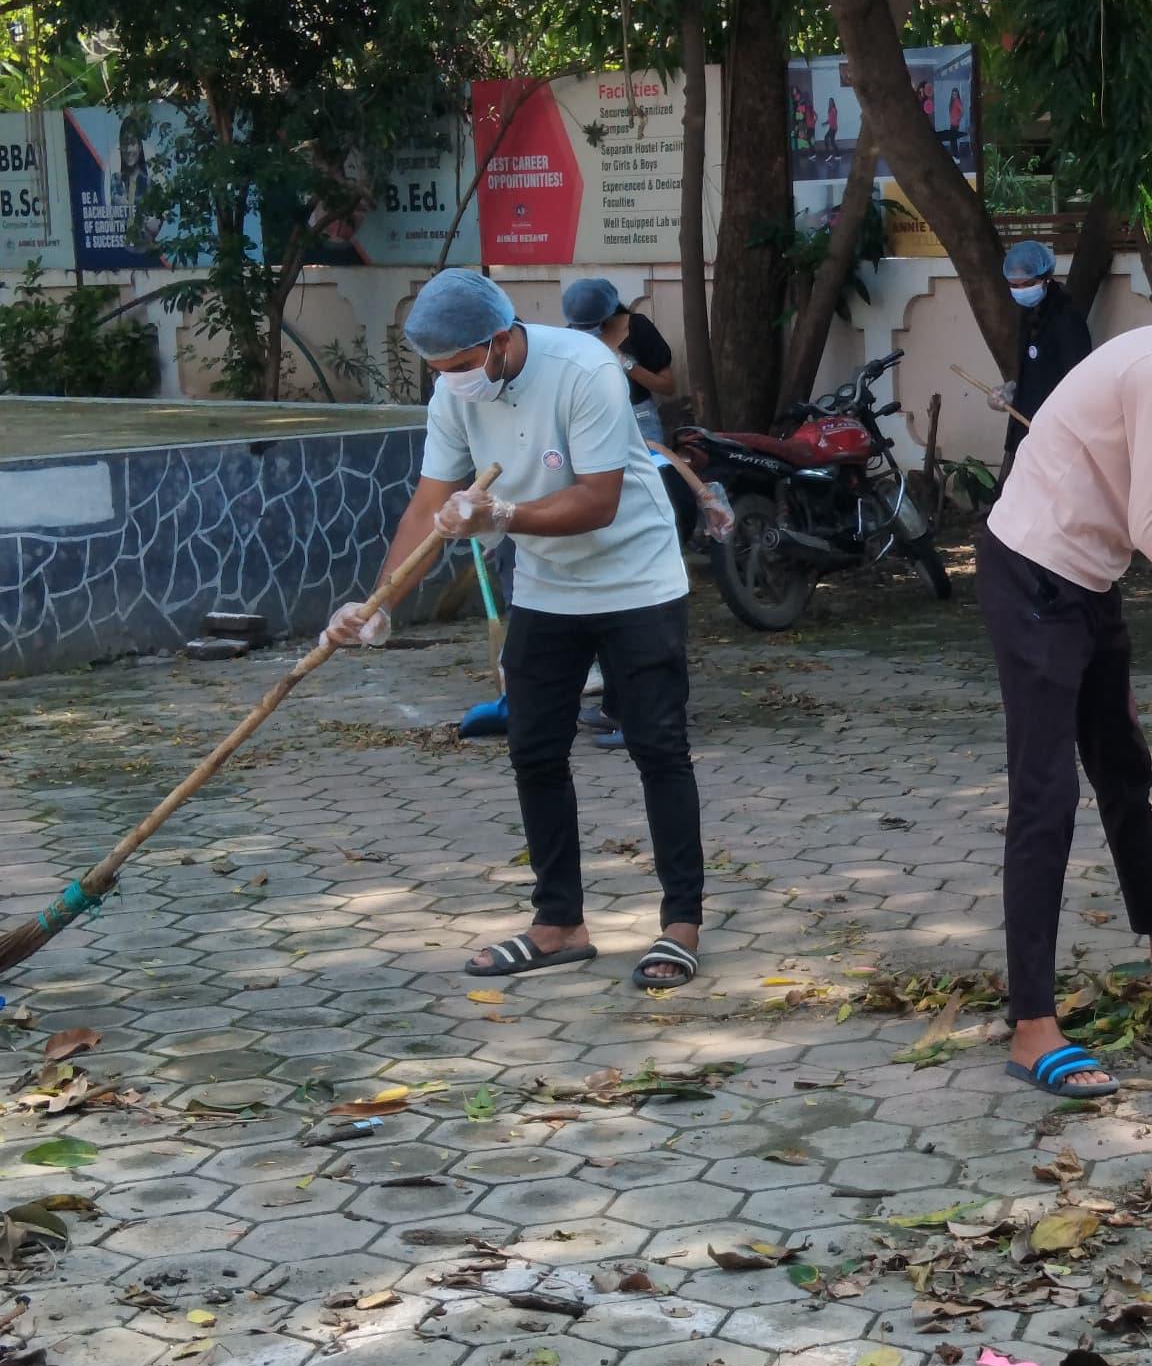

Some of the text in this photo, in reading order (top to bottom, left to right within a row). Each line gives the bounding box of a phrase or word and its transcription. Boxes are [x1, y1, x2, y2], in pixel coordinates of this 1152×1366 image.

[599, 82, 659, 99] Facities
[601, 144, 633, 157] Separate
[635, 141, 658, 154] Hostel
[487, 155, 549, 172] BEST CAREER
[602, 161, 611, 172] for
[613, 159, 631, 171] Girls
[640, 158, 658, 172] Boys
[488, 172, 563, 190] OPPORTUNITIES!
[602, 180, 646, 194] Experienced
[385, 181, 445, 212] B.Ed.
[602, 197, 635, 208] Faculties
[603, 217, 620, 229] Well
[621, 217, 654, 229] Equipped
[656, 216, 670, 227] Lab
[603, 234, 658, 245] Internet Access
